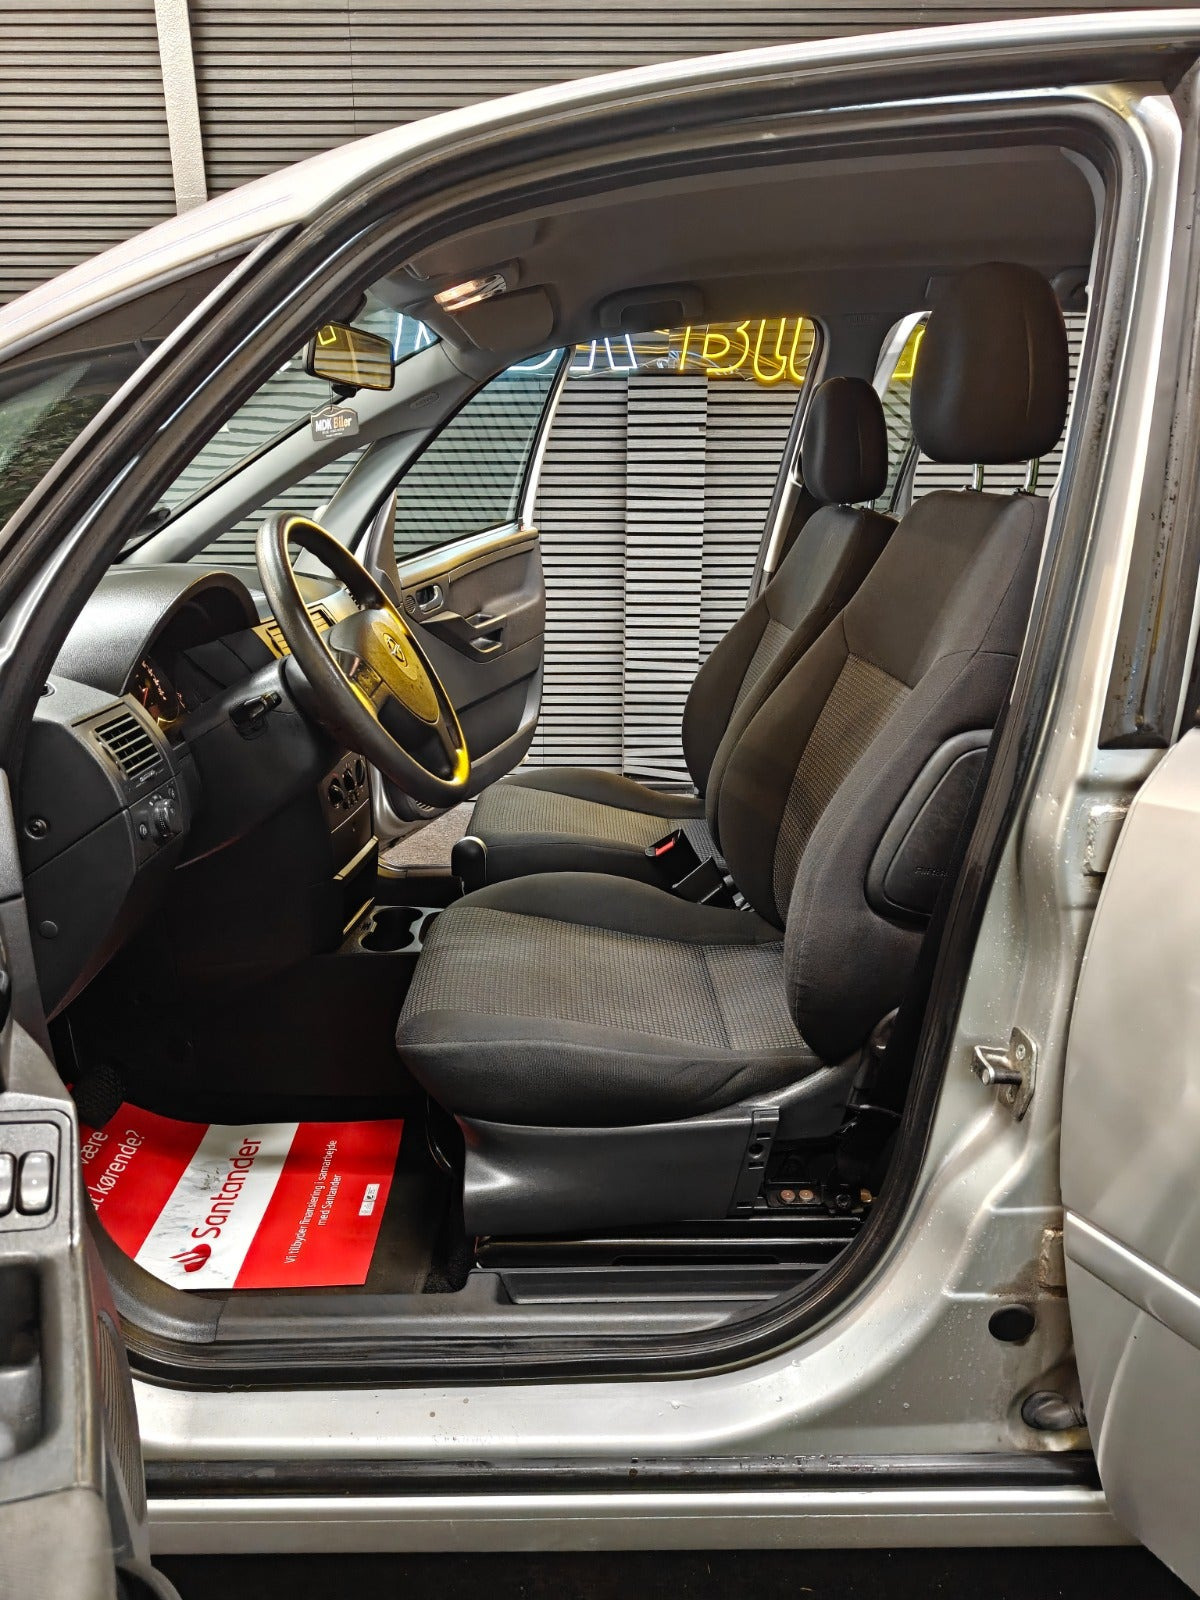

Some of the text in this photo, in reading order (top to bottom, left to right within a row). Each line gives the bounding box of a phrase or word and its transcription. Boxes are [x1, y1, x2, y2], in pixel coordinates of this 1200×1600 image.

[315, 418, 332, 432] MDK
[87, 1129, 145, 1195] kørende?
[318, 1140, 338, 1181] samarbejde
[191, 1138, 262, 1238] Santander
[299, 1183, 325, 1225] finansiering
[318, 1174, 341, 1226] med Santander
[284, 1255, 297, 1264] Vi
[288, 1225, 307, 1254] tilbyder
